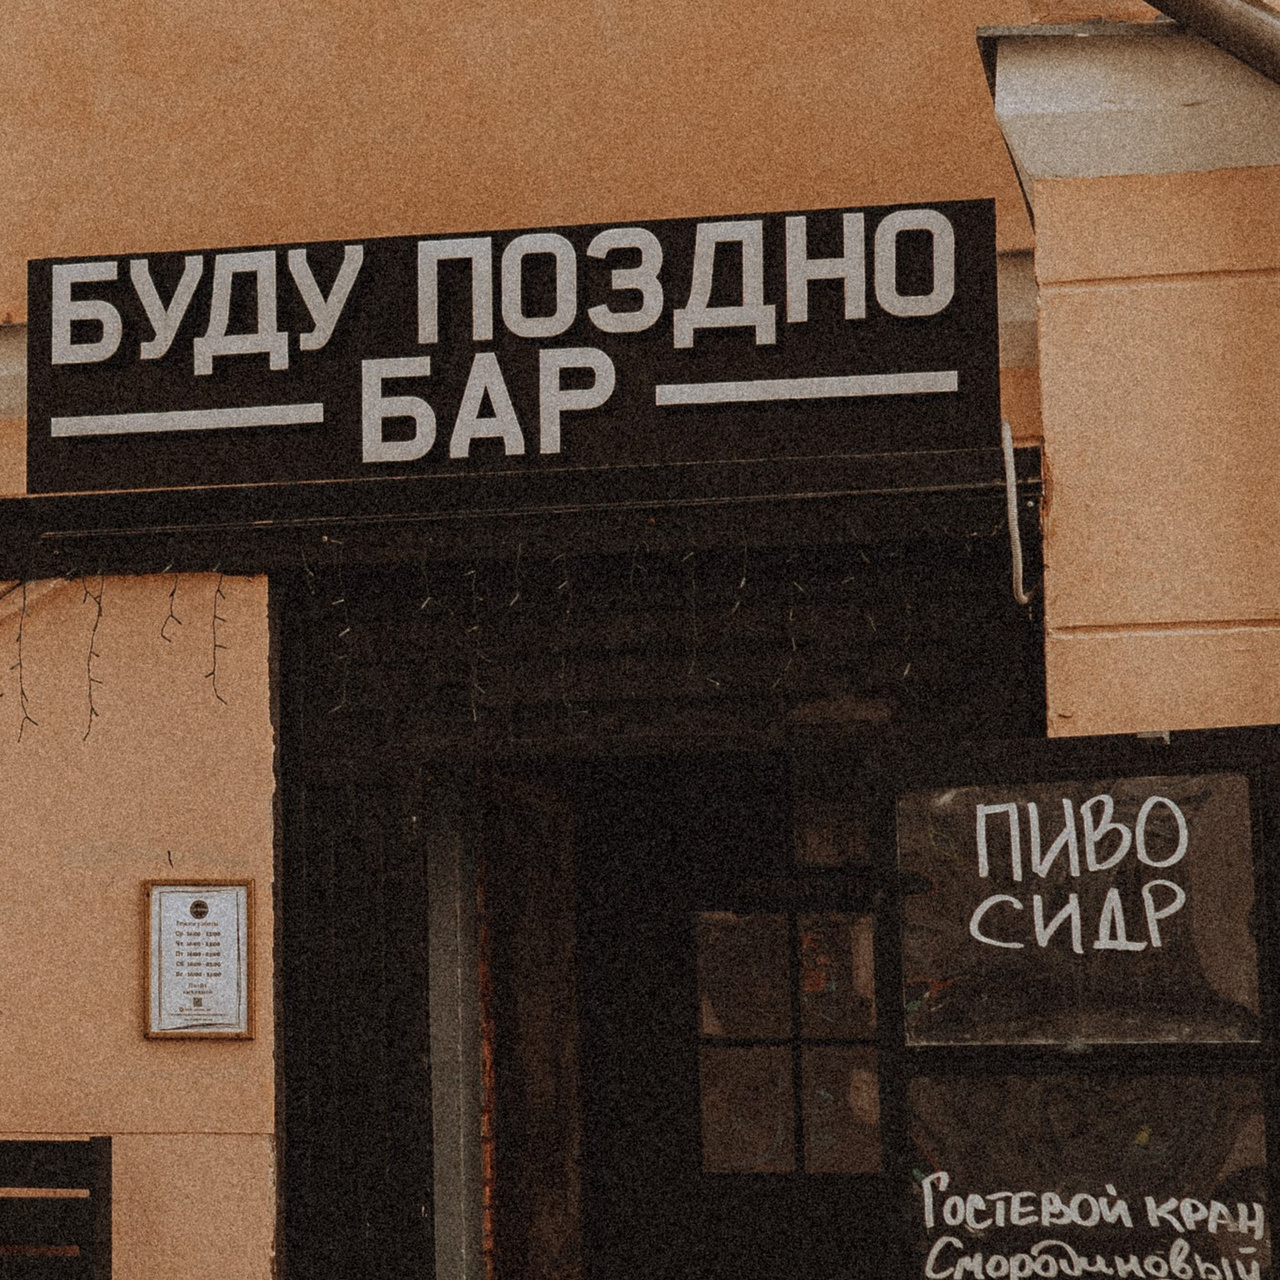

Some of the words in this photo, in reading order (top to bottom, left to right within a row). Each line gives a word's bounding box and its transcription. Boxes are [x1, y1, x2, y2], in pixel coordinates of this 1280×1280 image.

[51, 245, 364, 376] БУДУ
[417, 208, 957, 349] ПОЗДНО
[361, 346, 616, 464] БАР
[975, 793, 1189, 882] ПИВО
[969, 878, 1186, 954] СИДР
